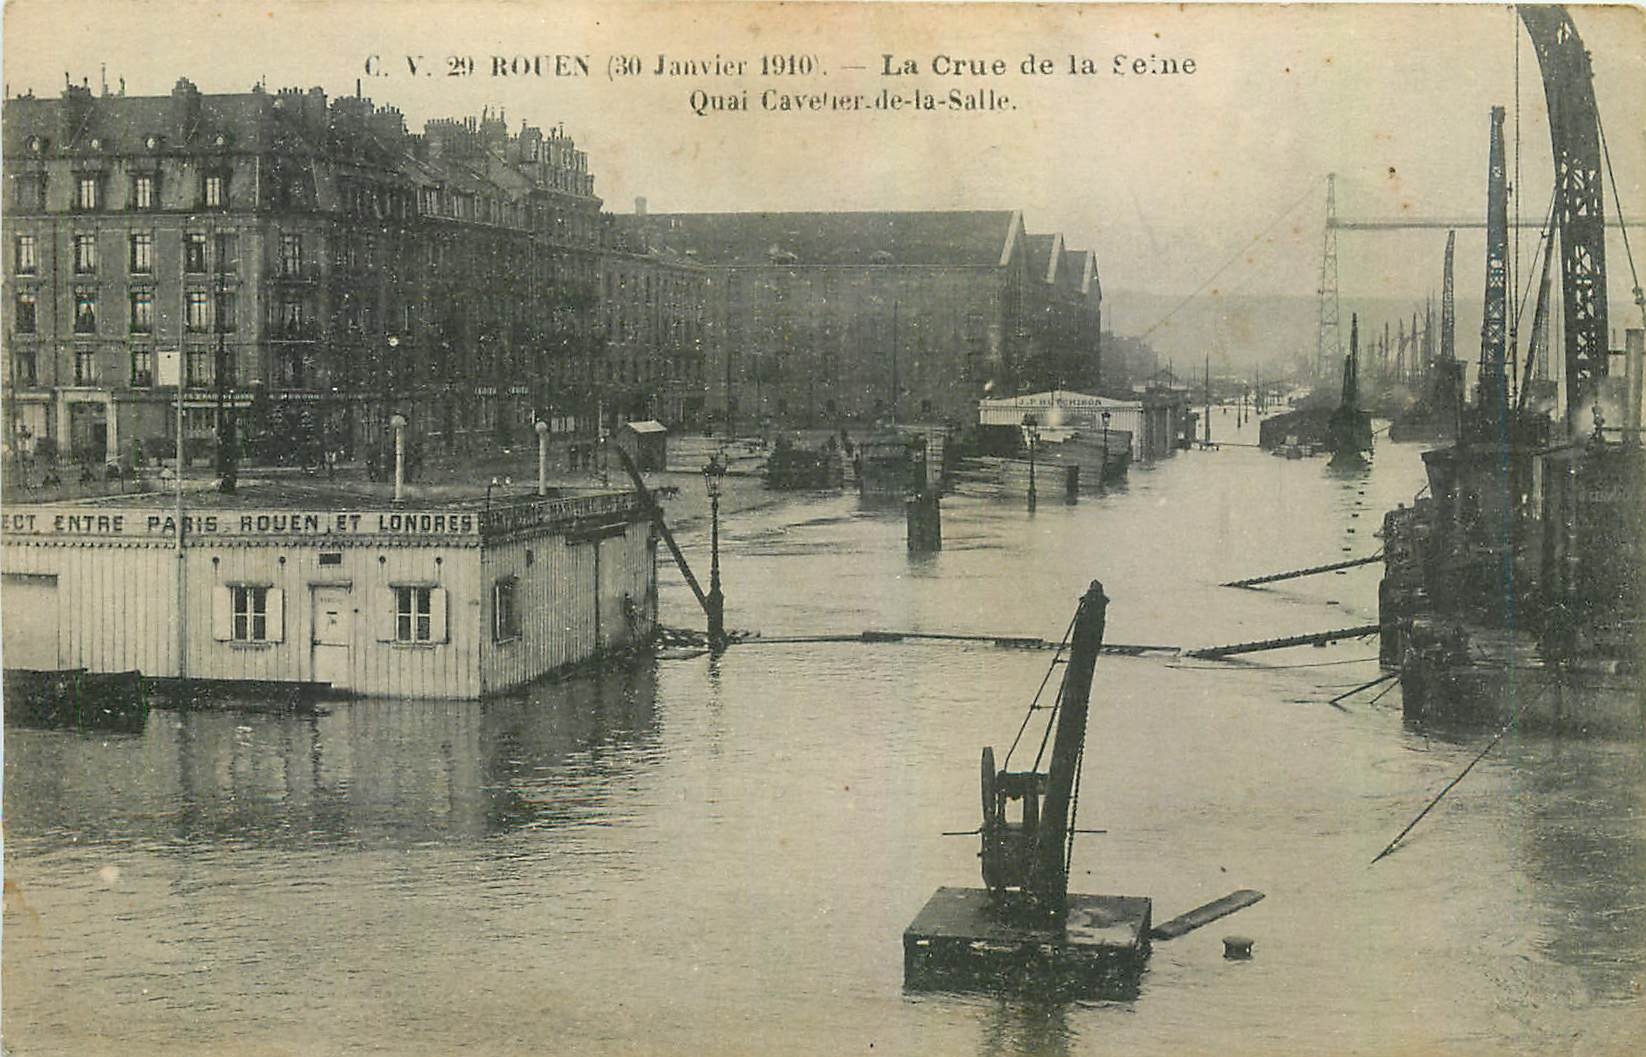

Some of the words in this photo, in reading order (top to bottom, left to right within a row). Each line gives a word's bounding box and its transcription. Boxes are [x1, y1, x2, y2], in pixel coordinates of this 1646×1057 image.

[53, 515, 124, 532] ENTRE
[241, 514, 318, 532] ROUEN
[336, 514, 362, 532] ET
[379, 514, 472, 532] LONDRES
